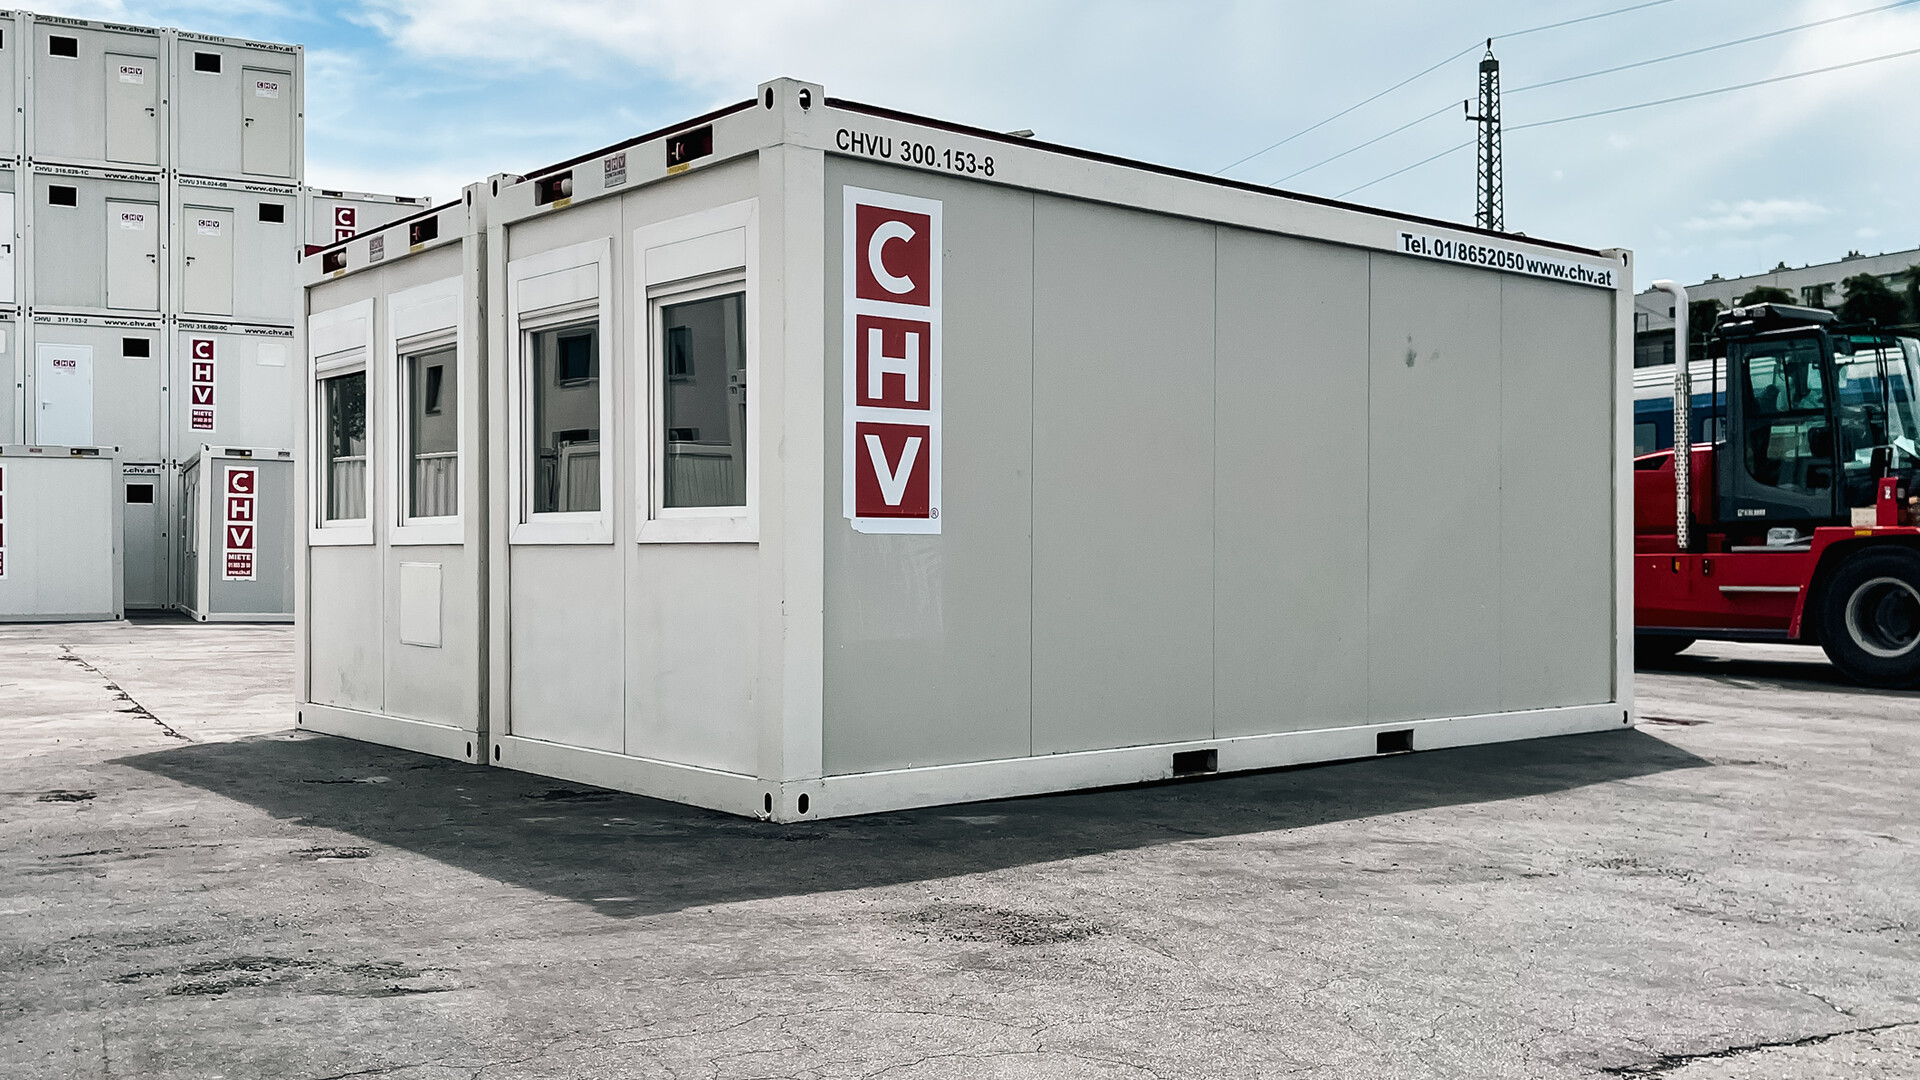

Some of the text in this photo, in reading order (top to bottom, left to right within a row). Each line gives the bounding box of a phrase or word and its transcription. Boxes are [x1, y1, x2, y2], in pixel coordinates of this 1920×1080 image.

[103, 23, 156, 35] www.chv.at
[244, 42, 294, 52] www.chv.at
[836, 128, 995, 177] CHVU 300.153-8
[605, 156, 625, 172] CHV
[104, 173, 156, 182] www.chv.at
[244, 185, 293, 194] www.chv.at
[338, 209, 353, 240] CH
[1401, 233, 1612, 286] Tel. 01/8652050 www.chv.at
[104, 320, 156, 328] www.chv.at
[244, 328, 293, 336] www.chv.at
[864, 220, 923, 506] CHV
[194, 341, 212, 403] CHV
[230, 472, 251, 547] CHV
